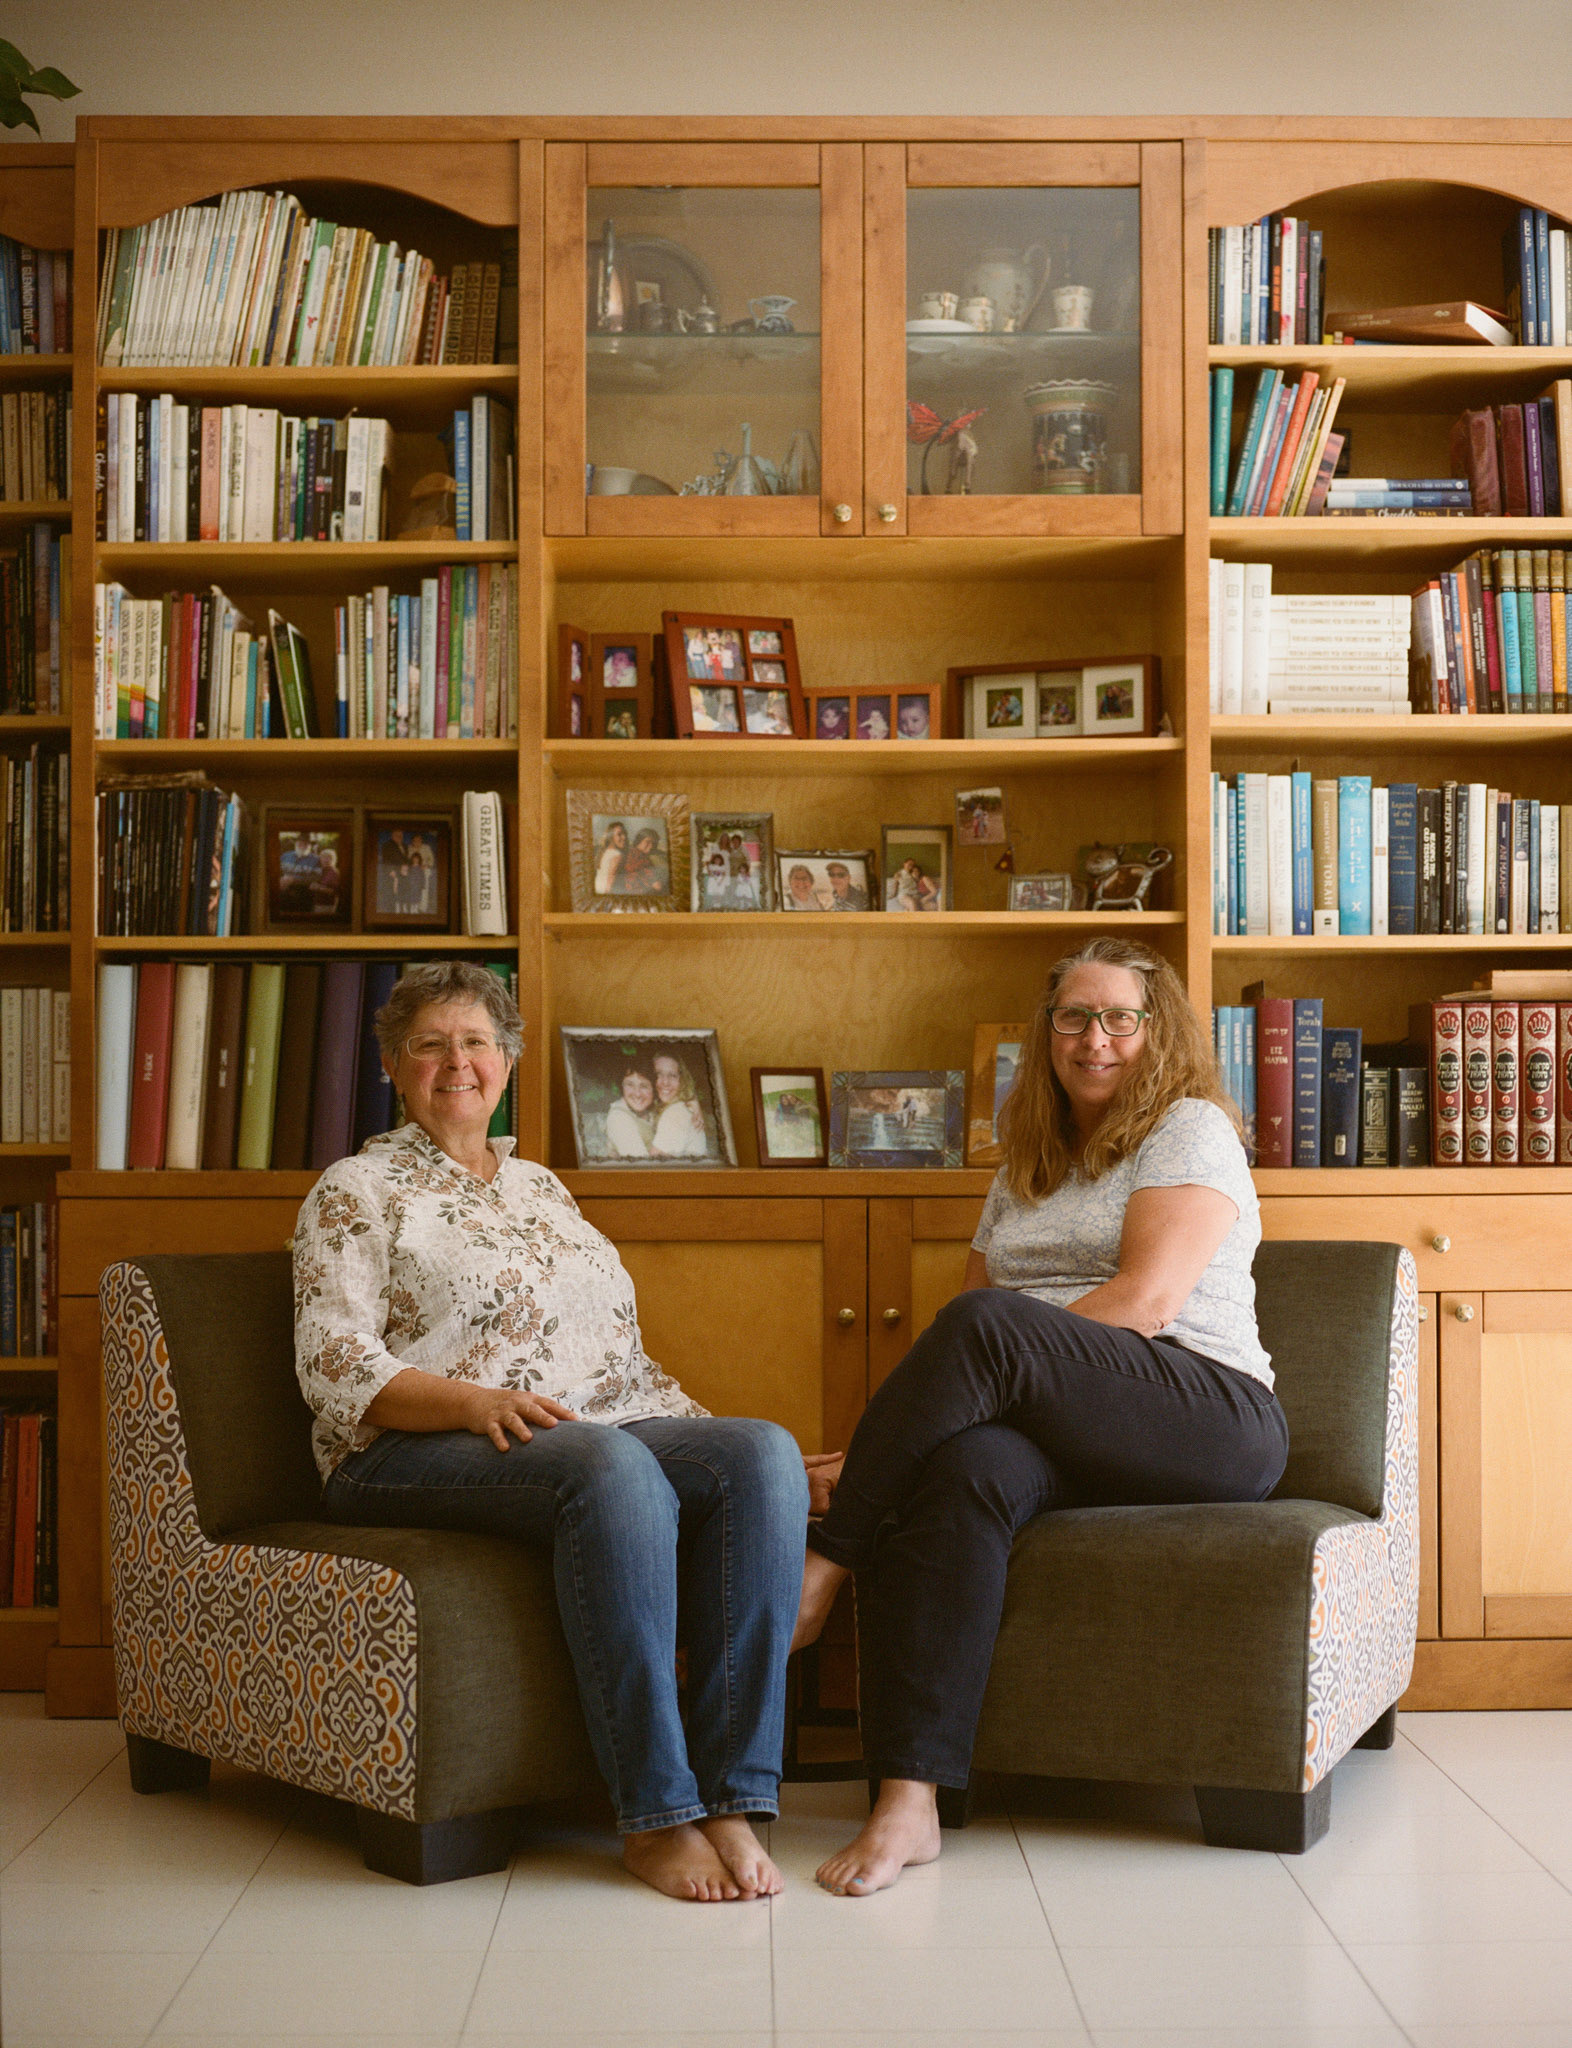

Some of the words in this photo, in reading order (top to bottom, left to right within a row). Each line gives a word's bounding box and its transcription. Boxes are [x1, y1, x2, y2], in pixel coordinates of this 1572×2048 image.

[23, 308, 34, 336] DOYLE
[456, 482, 468, 529] ISRAEL
[1506, 629, 1516, 670] AMIDAH
[1238, 779, 1246, 814] BIBLE
[480, 804, 492, 857] GREAT
[1323, 800, 1331, 855] COMMENTARY
[1521, 808, 1529, 822] THE
[1238, 820, 1246, 864] BASICS
[1521, 824, 1529, 843] BIBLE
[480, 862, 492, 911] TIMES
[1323, 863, 1333, 906] TORAH
[1549, 863, 1557, 879] THE
[1549, 882, 1557, 905] BIBLE
[1296, 1017, 1321, 1027] Torah
[1264, 1056, 1289, 1064] HAYIM
[1269, 1046, 1283, 1055] ETZ
